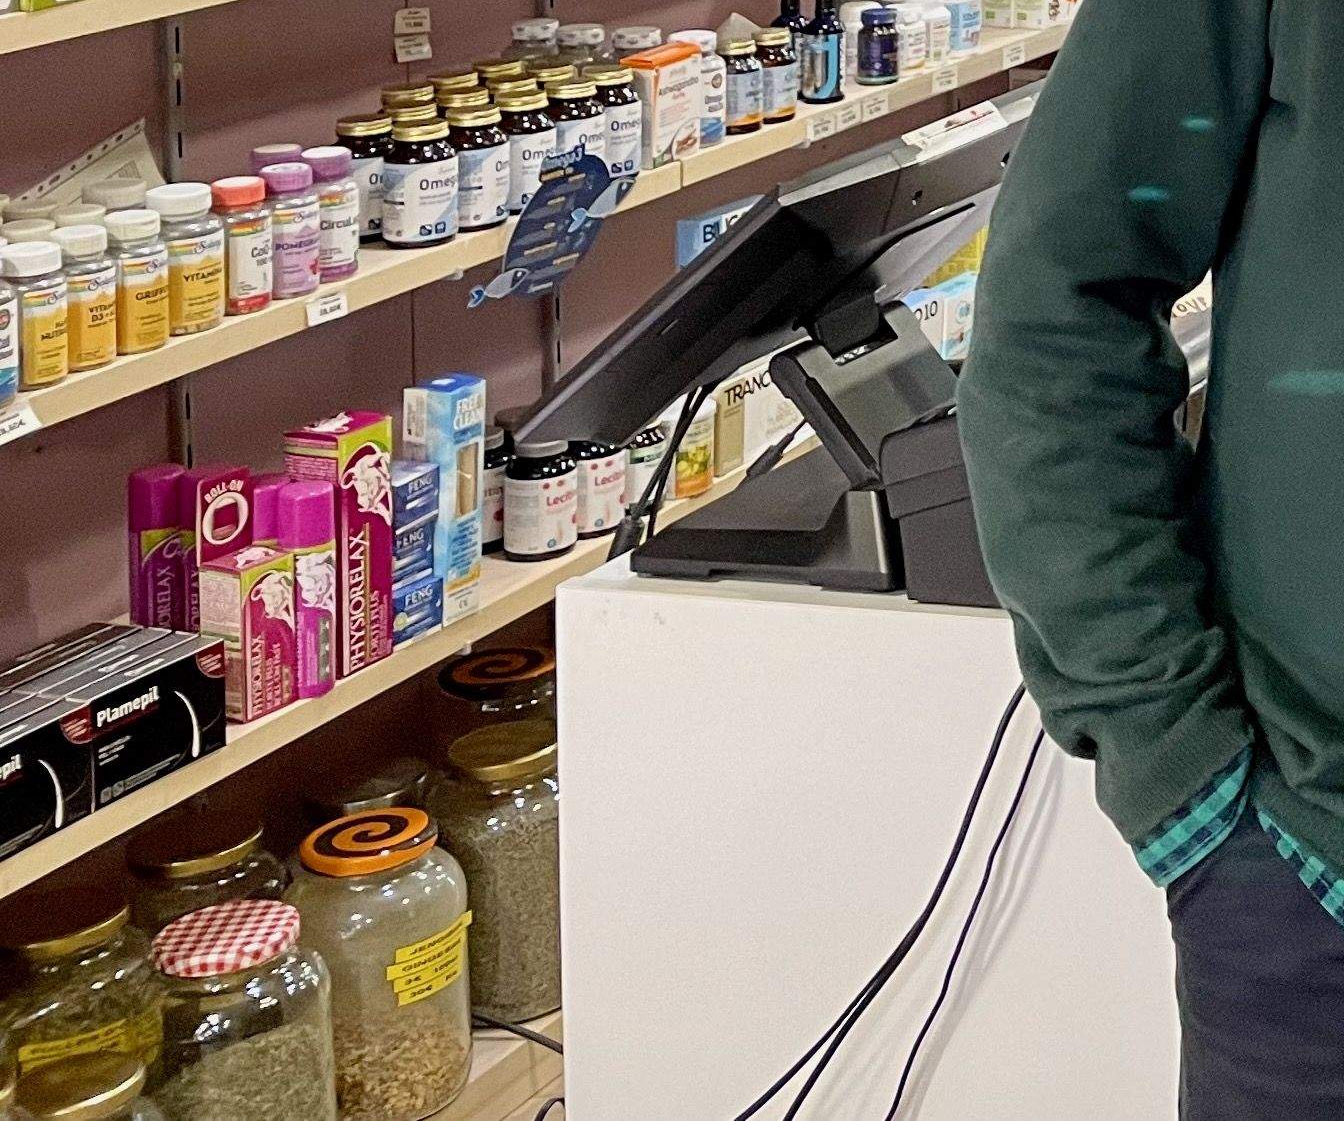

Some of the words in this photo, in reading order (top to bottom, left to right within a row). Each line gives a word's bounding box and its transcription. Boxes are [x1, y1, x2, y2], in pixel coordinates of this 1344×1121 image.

[204, 479, 244, 504] ROLL-ON
[408, 476, 433, 494] FENG
[349, 529, 369, 672] PHYSIORELAX
[404, 587, 434, 606] FENG
[96, 685, 160, 728] Plamepil
